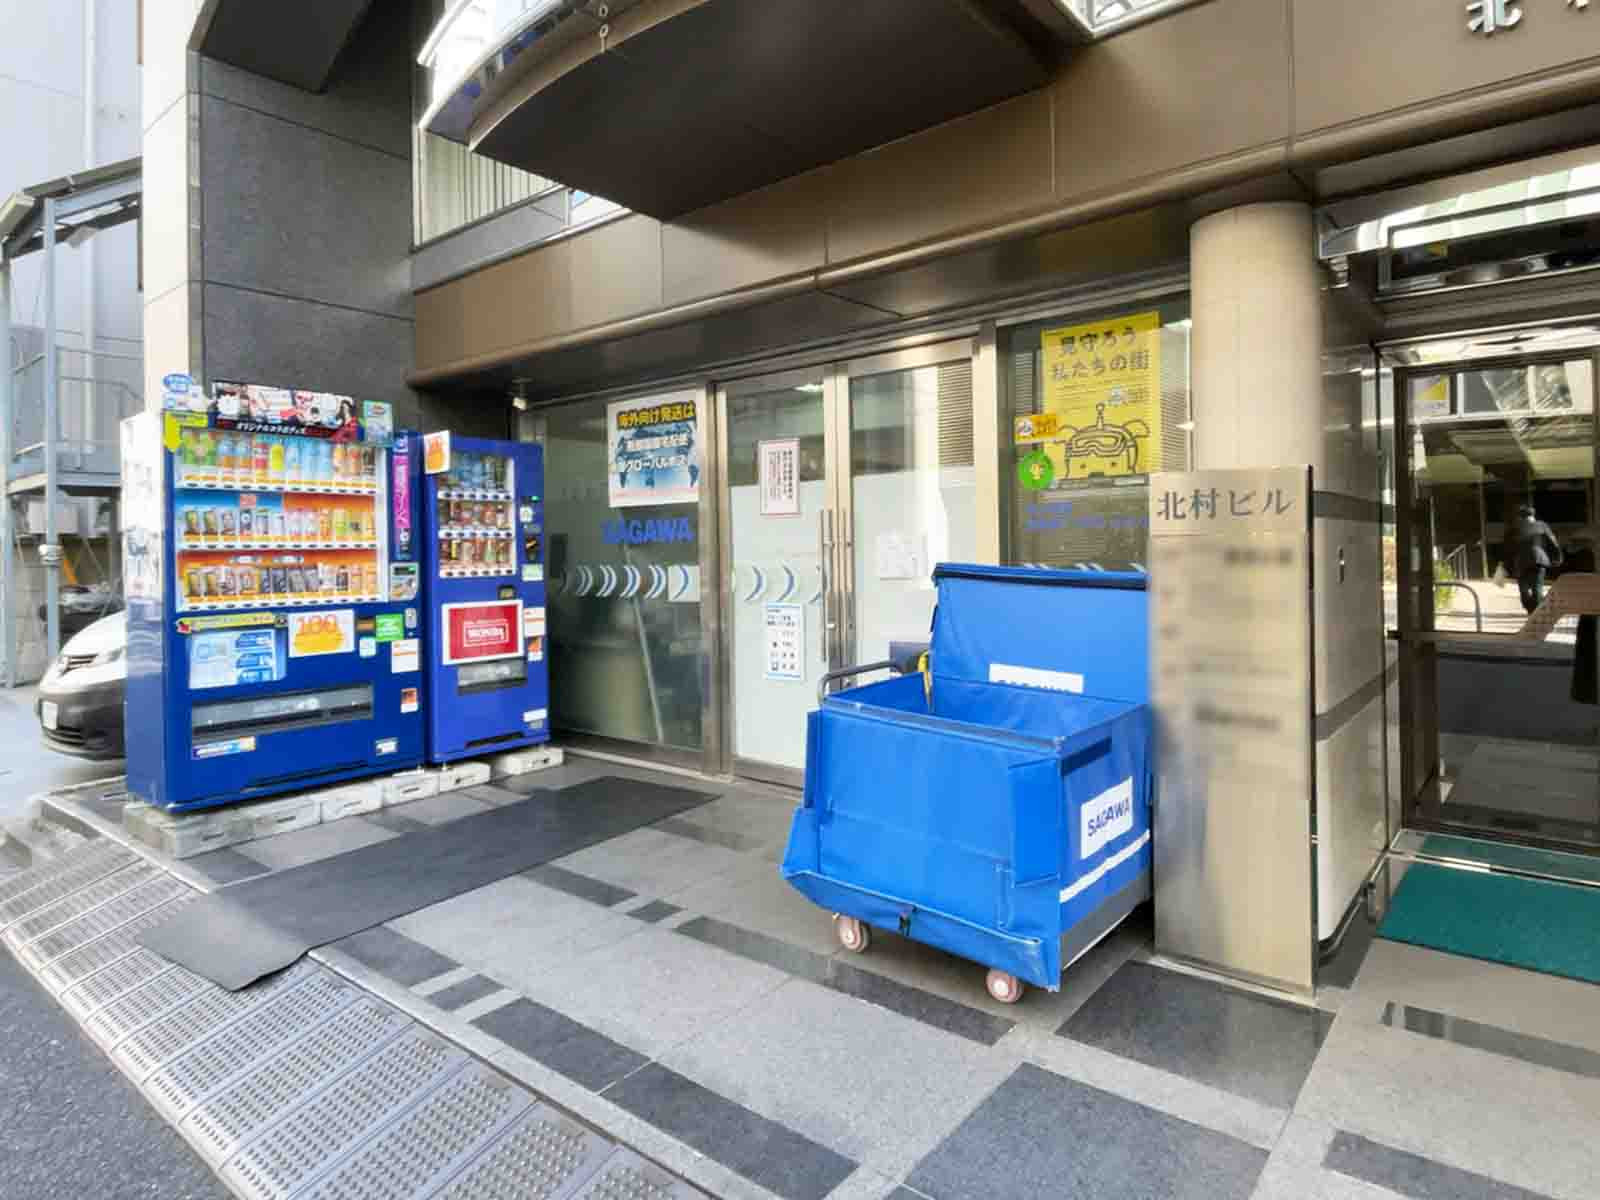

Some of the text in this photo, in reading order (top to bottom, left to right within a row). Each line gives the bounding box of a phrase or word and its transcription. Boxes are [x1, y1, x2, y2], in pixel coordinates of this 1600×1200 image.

[1052, 348, 1150, 381] 私たちの街
[1156, 486, 1294, 521] 北村ビル
[1087, 797, 1129, 837] SAGAWA
